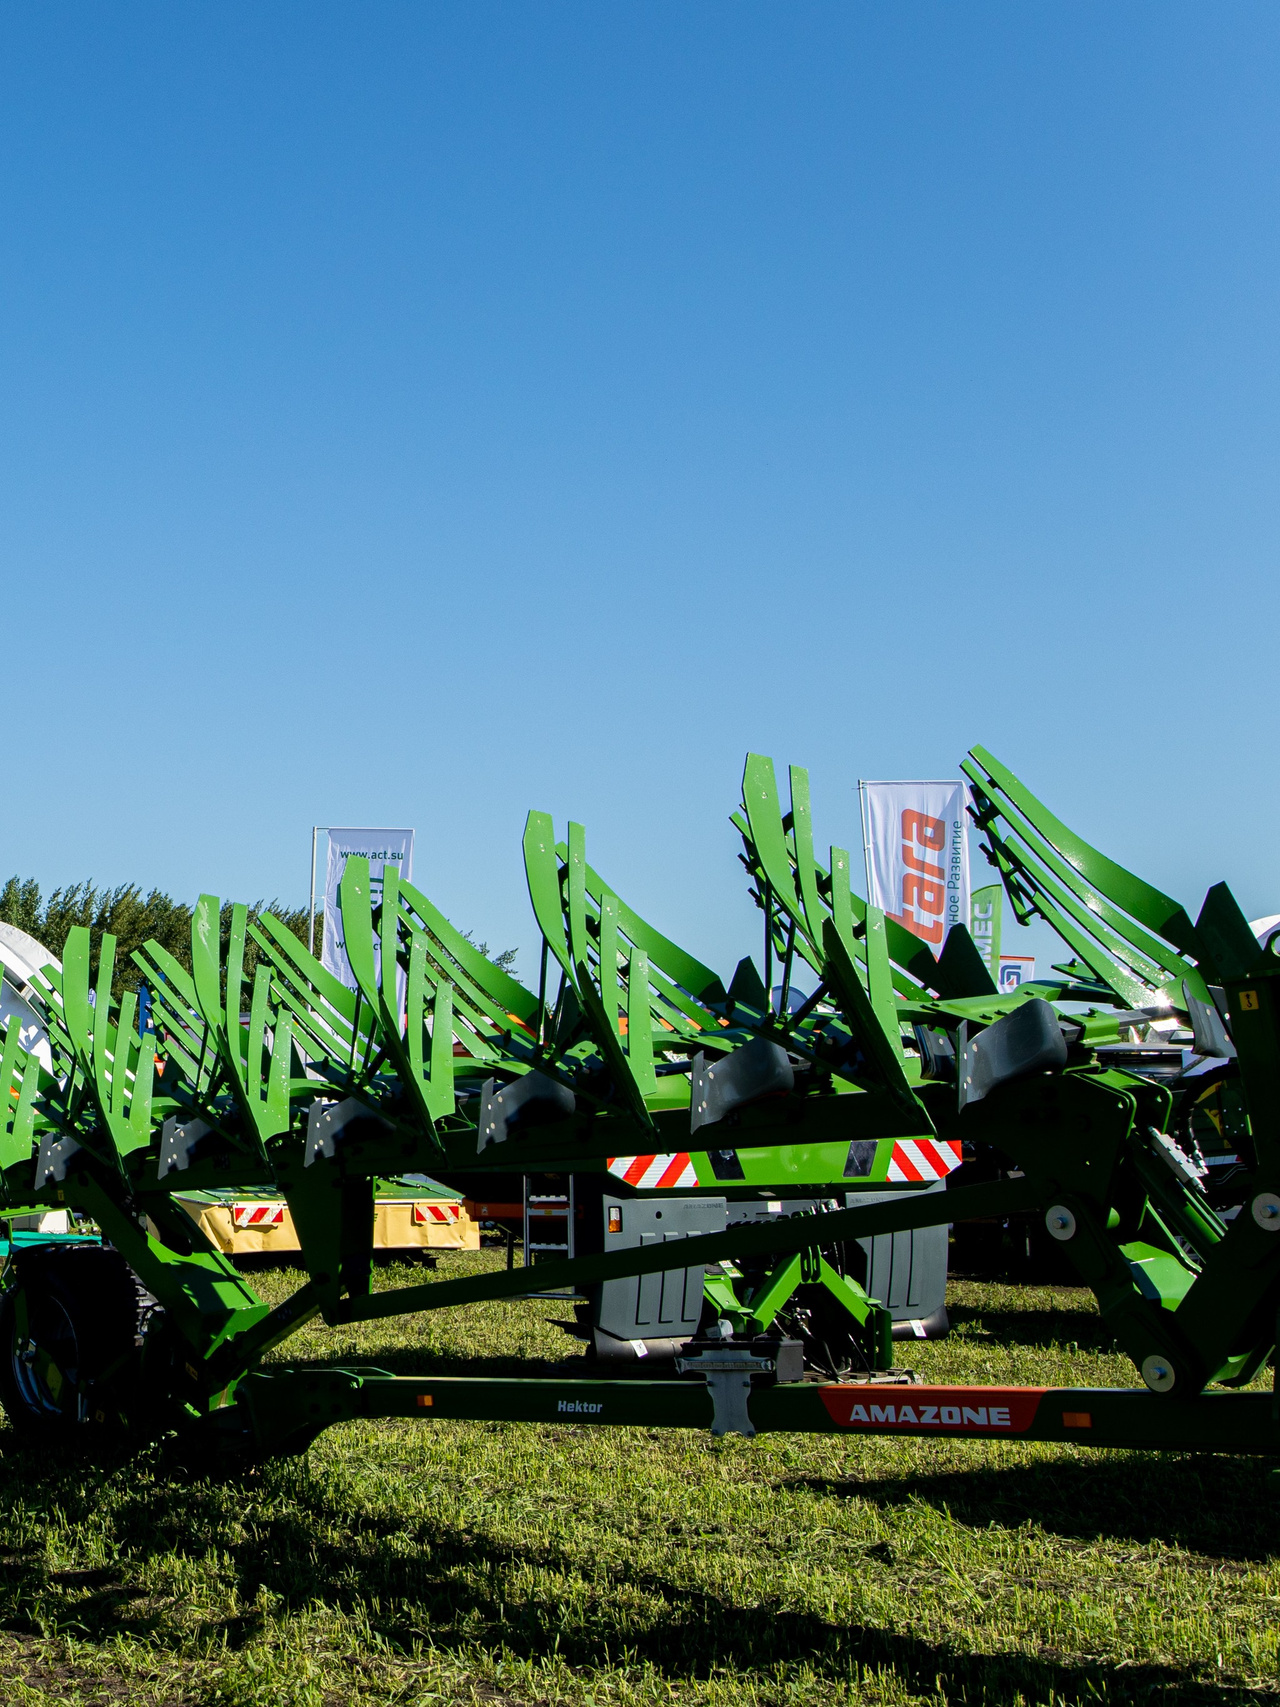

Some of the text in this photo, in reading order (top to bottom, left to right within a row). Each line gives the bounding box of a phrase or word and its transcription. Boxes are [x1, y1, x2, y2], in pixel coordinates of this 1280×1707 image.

[340, 849, 404, 861] www.act.su
[947, 820, 962, 890] Развитие
[557, 1400, 603, 1413] Hektor
[849, 1404, 1011, 1426] AMAZONE
